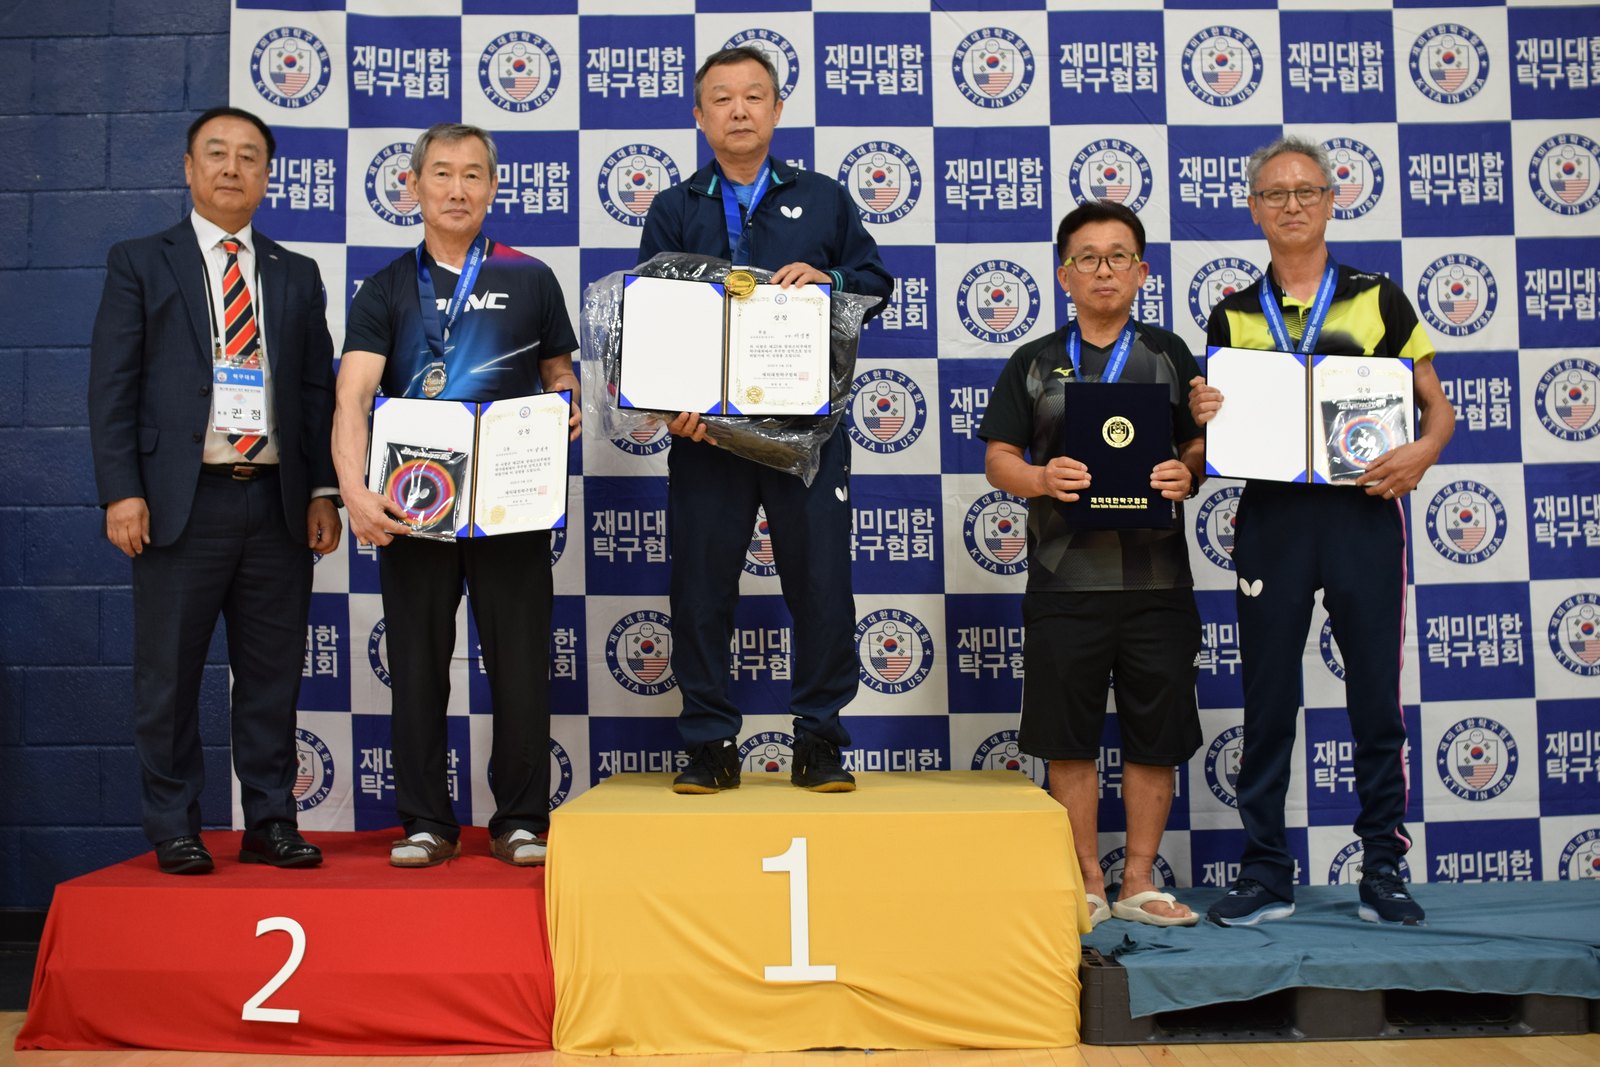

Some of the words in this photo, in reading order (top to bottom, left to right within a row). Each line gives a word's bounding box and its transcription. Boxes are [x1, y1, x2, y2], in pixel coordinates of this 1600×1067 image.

[254, 28, 329, 60] 재미대한탁구협회
[481, 32, 558, 63] 재미대한탁구협회
[725, 30, 796, 61] 미대한탁구협회
[954, 28, 1032, 60] 재미대한탁구협회
[1184, 27, 1260, 58] 재미대한탁구협회
[1411, 24, 1487, 56] 재미대한탁구협회
[353, 46, 451, 73] 재미대한
[587, 47, 685, 72] 재미대한
[825, 44, 923, 70] 재미대한
[1060, 42, 1158, 67] 재미대한
[1288, 42, 1383, 67] 재미대한
[353, 70, 449, 98] 탁구협회
[587, 72, 684, 98] 탁구협회
[779, 84, 793, 98] SA
[826, 70, 922, 95] 탁구협회
[1060, 67, 1157, 93] 탁구협회
[1289, 67, 1383, 92] 탁구협회
[1415, 80, 1442, 102] KTTA
[1449, 94, 1460, 103] IN
[1465, 78, 1485, 98] USA
[256, 82, 282, 105] KTTA
[288, 99, 299, 107] IN
[304, 84, 325, 103] USA
[484, 87, 511, 110] KTTA
[518, 103, 530, 111] IN
[535, 87, 555, 106] USA
[959, 84, 986, 106] KTTA
[992, 98, 1004, 107] IN
[1009, 82, 1029, 102] USA
[1188, 82, 1214, 104] KTTA
[1221, 97, 1232, 106] IN
[1237, 81, 1257, 101] USA
[368, 143, 413, 176] 재미대한탁
[600, 145, 677, 177] 재미대한탁구협회
[840, 142, 918, 174] 재미대한탁구협회
[1071, 140, 1149, 172] 재미대한탁구협회
[1323, 139, 1381, 171] 대한탁구협회
[1530, 134, 1599, 167] 재미대한탁구협
[270, 158, 335, 184] 미대한
[499, 162, 570, 188] 미대한
[945, 158, 1043, 184] 재미대한
[1179, 156, 1249, 181] 재미대
[1408, 152, 1504, 179] 재미대한
[266, 184, 334, 211] 구협회
[496, 188, 569, 213] 구협회
[946, 183, 1042, 210] 탁구협회
[1180, 182, 1249, 208] 탁구협
[1410, 178, 1503, 205] 탁구협회
[1534, 191, 1561, 214] KTTA
[1568, 206, 1579, 215] IN
[1584, 189, 1599, 210] US
[371, 200, 398, 223] KTTA
[405, 216, 416, 224] IN
[604, 201, 631, 224] KTTA
[878, 214, 889, 223] IN
[895, 198, 915, 218] USA
[1341, 210, 1353, 218] IN
[1358, 193, 1378, 214] USA
[959, 261, 1038, 294] 재미대한탁구협회
[1190, 258, 1262, 291] 재미대한탁구협
[1420, 255, 1495, 287] 재미대한탁구협회
[1525, 268, 1595, 294] 재미대
[1526, 294, 1595, 321] 탁구협
[963, 318, 991, 341] KTTA
[998, 334, 1010, 342] IN
[1015, 317, 1035, 337] USA
[1424, 312, 1451, 334] KTTA
[1457, 327, 1468, 335] IN
[1473, 309, 1492, 330] USA
[1537, 360, 1596, 392] 재미대한탁구
[1448, 378, 1511, 404] 미대한
[849, 427, 876, 451] KTTA
[883, 443, 895, 452] IN
[900, 426, 920, 447] USA
[1541, 416, 1568, 439] KTTA
[1575, 431, 1586, 440] IN
[642, 445, 654, 454] IN
[966, 492, 1025, 524] 재미대한탁구
[1198, 488, 1233, 520] 재미대한
[1429, 481, 1504, 514] 재미대한탁구협회
[1534, 495, 1600, 521] 재미대
[592, 510, 665, 536] 재미대
[1535, 521, 1600, 548] 탁구협
[593, 536, 665, 562] 탁구협
[970, 549, 998, 572] KTTA
[1004, 565, 1016, 573] IN
[1202, 545, 1230, 568] KTTA
[1433, 539, 1460, 562] KTTA
[1466, 554, 1478, 563] IN
[1482, 537, 1501, 558] USA
[743, 562, 752, 574] TA
[763, 566, 775, 574] IN
[1550, 594, 1597, 627] 재미대한탁
[608, 612, 668, 644] 재미대한탁구
[957, 627, 1025, 652] 재미대
[1202, 622, 1239, 648] 재미
[1426, 613, 1522, 641] 재미대한
[959, 653, 1024, 679] 탁구협
[1200, 650, 1242, 675] 탁구
[1427, 640, 1524, 668] 탁구협회
[1555, 652, 1582, 674] KTTA
[1588, 666, 1600, 675] IN
[612, 669, 640, 693] KTTA
[647, 685, 659, 694] IN
[889, 684, 901, 693] IN
[906, 667, 927, 688] USA
[295, 729, 331, 762] 탁구협회
[740, 733, 792, 757] 미대한탁구
[973, 731, 1013, 763] 재미대한
[1208, 727, 1243, 759] 재미대한
[1439, 718, 1515, 752] 재미대한탁구협회
[1546, 730, 1600, 756] 재미
[842, 748, 942, 771] 재미대한
[1547, 757, 1600, 784] 탁구
[307, 786, 328, 806] USA
[1212, 783, 1237, 806] KTTA
[1444, 776, 1471, 799] KTTA
[1478, 791, 1489, 800] IN
[1494, 774, 1513, 794] USA
[1436, 849, 1533, 879] 재미대한
[762, 837, 837, 982] 1
[242, 917, 306, 1024] 2
